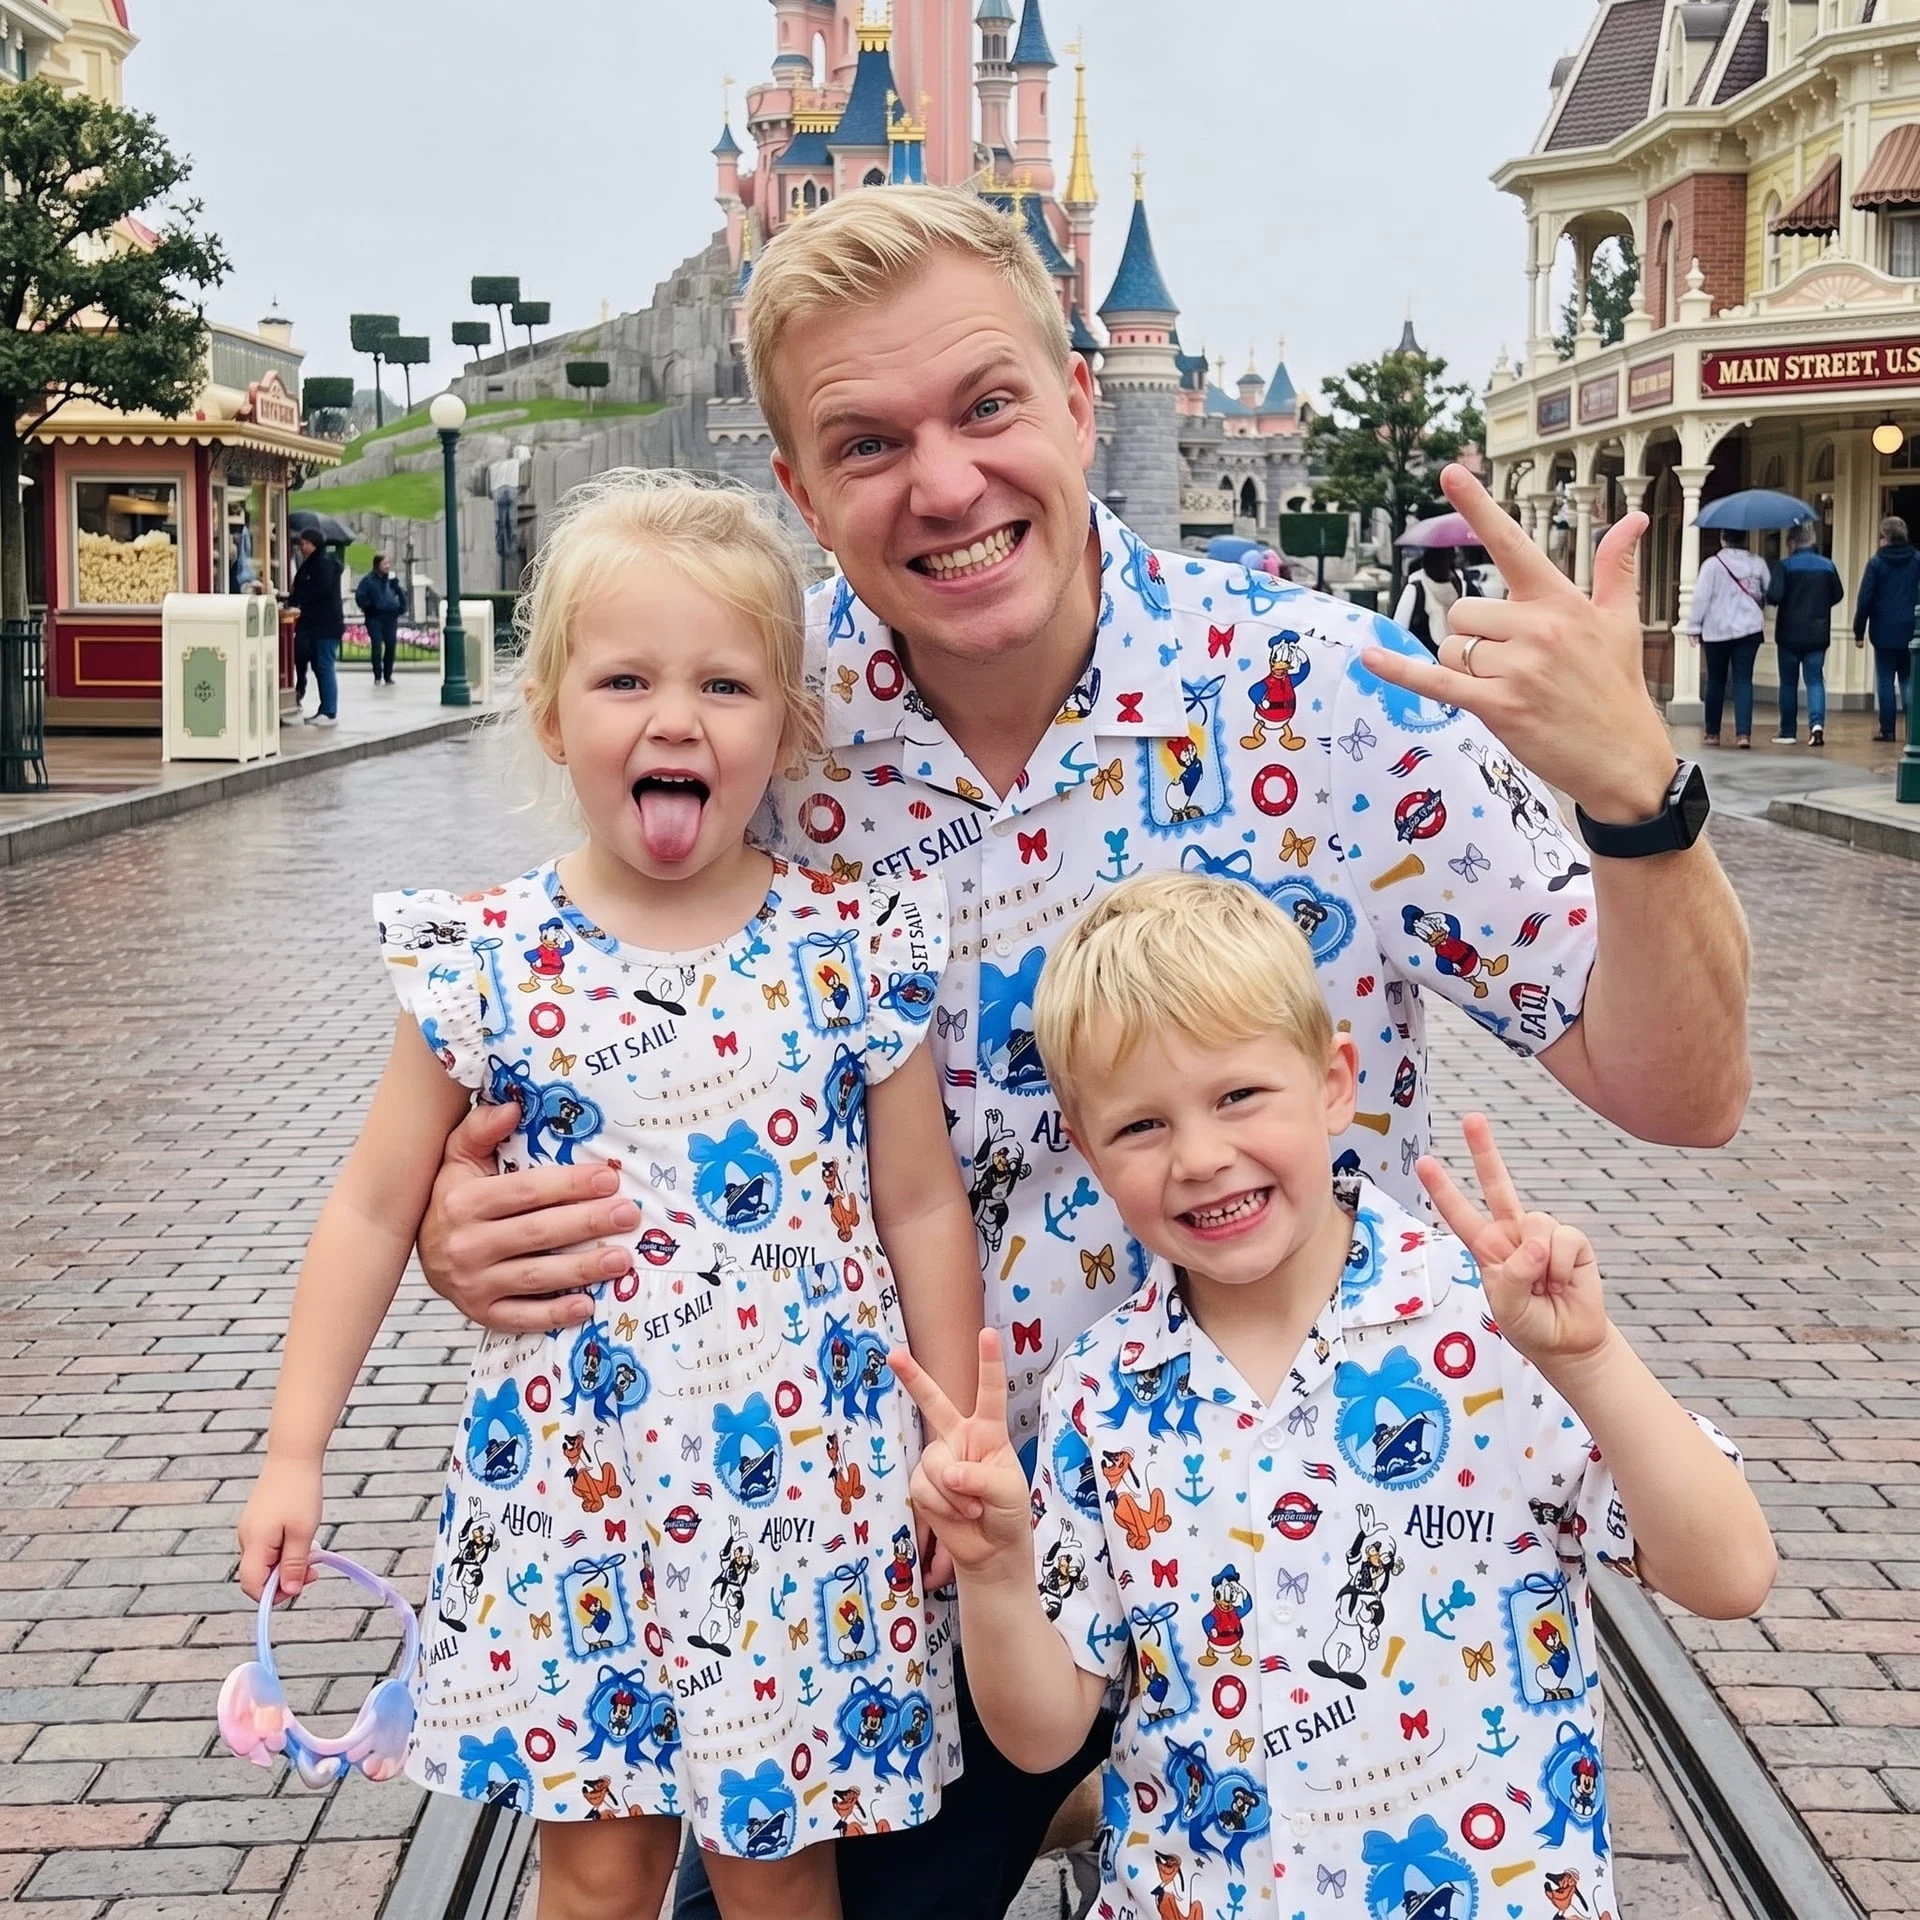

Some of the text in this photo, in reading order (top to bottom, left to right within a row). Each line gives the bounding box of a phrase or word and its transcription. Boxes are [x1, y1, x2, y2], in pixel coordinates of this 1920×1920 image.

[1719, 357, 1779, 384] MAIN
[1785, 350, 1879, 379] STREET,
[1026, 897, 1079, 932] LINE
[910, 942, 928, 973] SET
[585, 1019, 677, 1076] SET SAIL!
[644, 1290, 713, 1341] SET SAIL!
[501, 1502, 552, 1539] AHOY!
[759, 1516, 815, 1552] AHOY!
[1404, 1504, 1494, 1549] AHOY!
